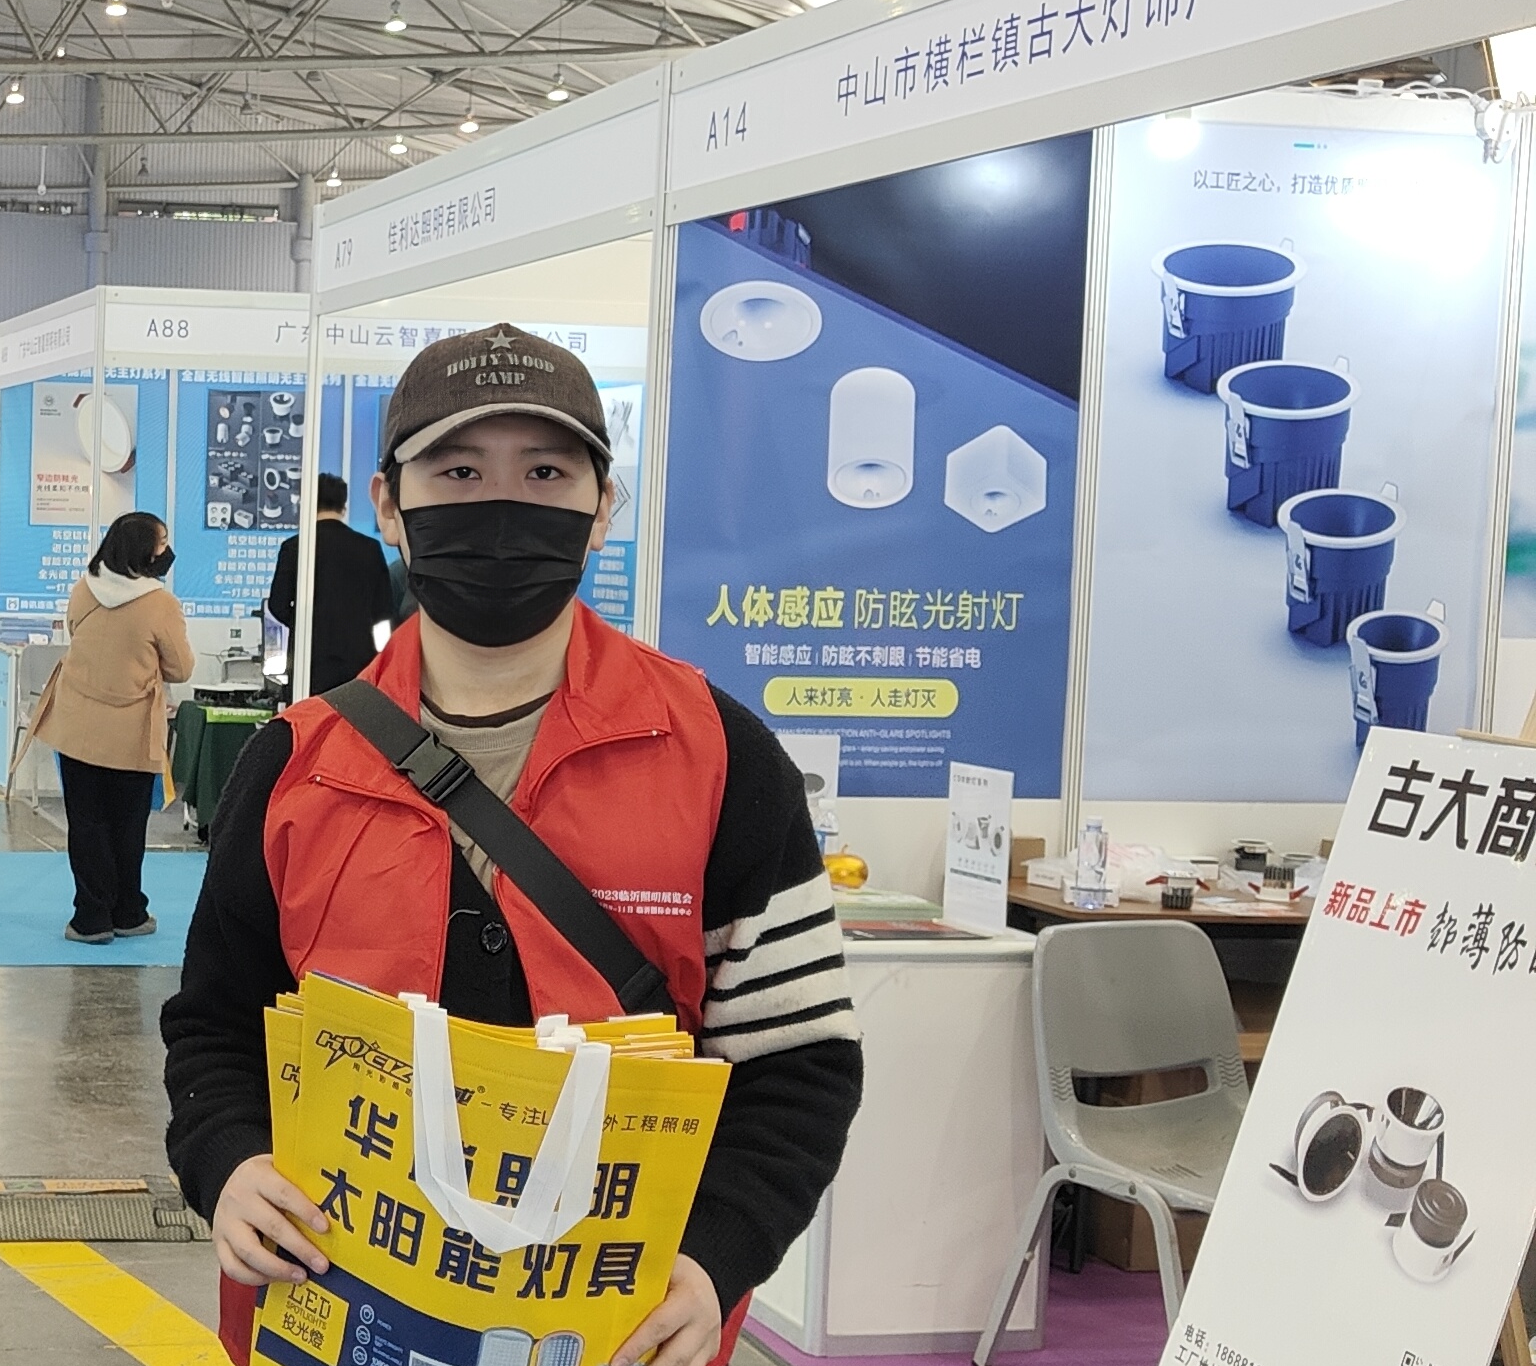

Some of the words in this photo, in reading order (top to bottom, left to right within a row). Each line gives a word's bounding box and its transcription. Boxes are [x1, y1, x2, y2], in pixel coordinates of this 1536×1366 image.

[706, 101, 748, 152] A14
[387, 186, 497, 255] 佳利达照明有限公司
[334, 238, 353, 269] A79
[146, 318, 191, 339] A88
[475, 372, 525, 387] CAMP
[706, 584, 844, 629] 人体感应
[854, 588, 1024, 631] 防眩光射灯
[745, 643, 813, 666] 智能感应
[822, 645, 905, 667] 防眩不刺眼
[915, 646, 981, 669] 节能省电
[591, 889, 693, 905] 2023临沂照明展览会
[1323, 880, 1427, 937] 新品上市
[1427, 901, 1536, 976] 超薄防
[286, 1301, 327, 1330] SPOTLIGHTS
[288, 1283, 332, 1320] LED
